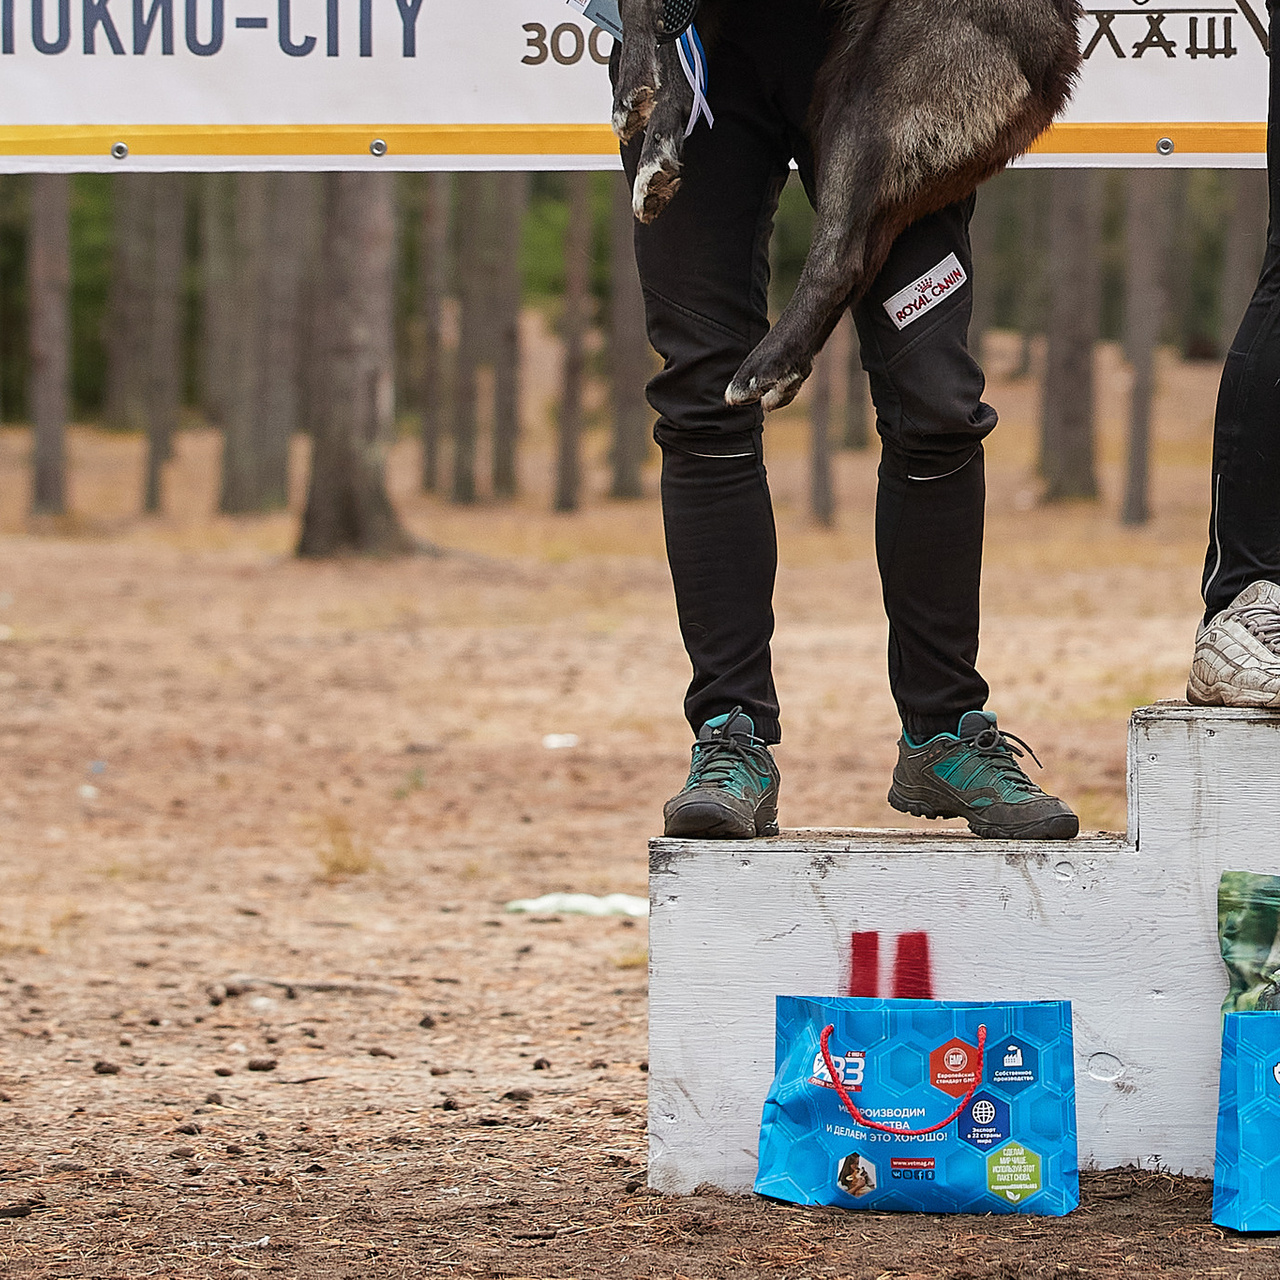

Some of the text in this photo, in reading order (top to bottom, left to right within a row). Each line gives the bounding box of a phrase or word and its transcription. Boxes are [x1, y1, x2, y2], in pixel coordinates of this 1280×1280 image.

[896, 268, 963, 322] ROYAL CANIN
[860, 1108, 925, 1118] РОИЗВОДИМ
[826, 1124, 832, 1132] И
[834, 1125, 867, 1140] ДЕЛАЕМ
[869, 1133, 891, 1142] ЭТО
